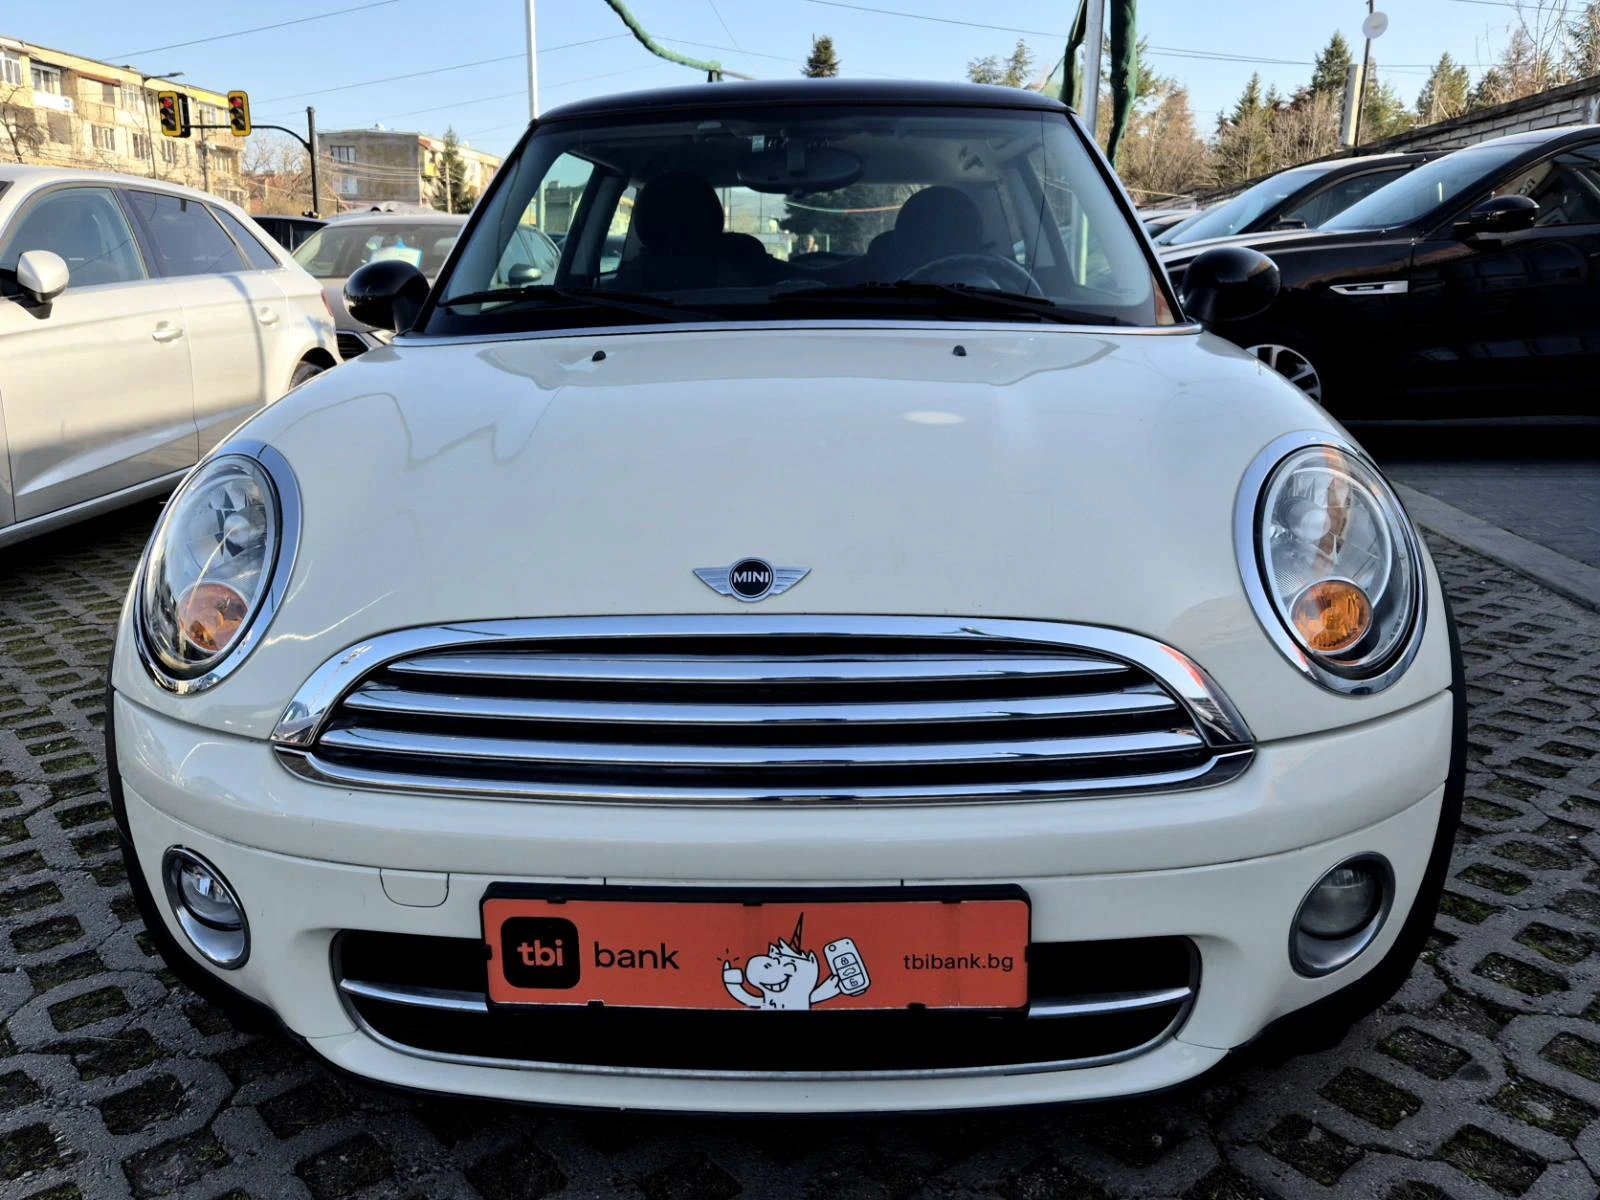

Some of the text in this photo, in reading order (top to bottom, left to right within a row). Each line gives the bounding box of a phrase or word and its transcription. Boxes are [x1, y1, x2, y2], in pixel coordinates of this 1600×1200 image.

[733, 571, 769, 583] MINI
[517, 939, 680, 970] tbi bank
[903, 952, 1014, 972] tbibank.bg
